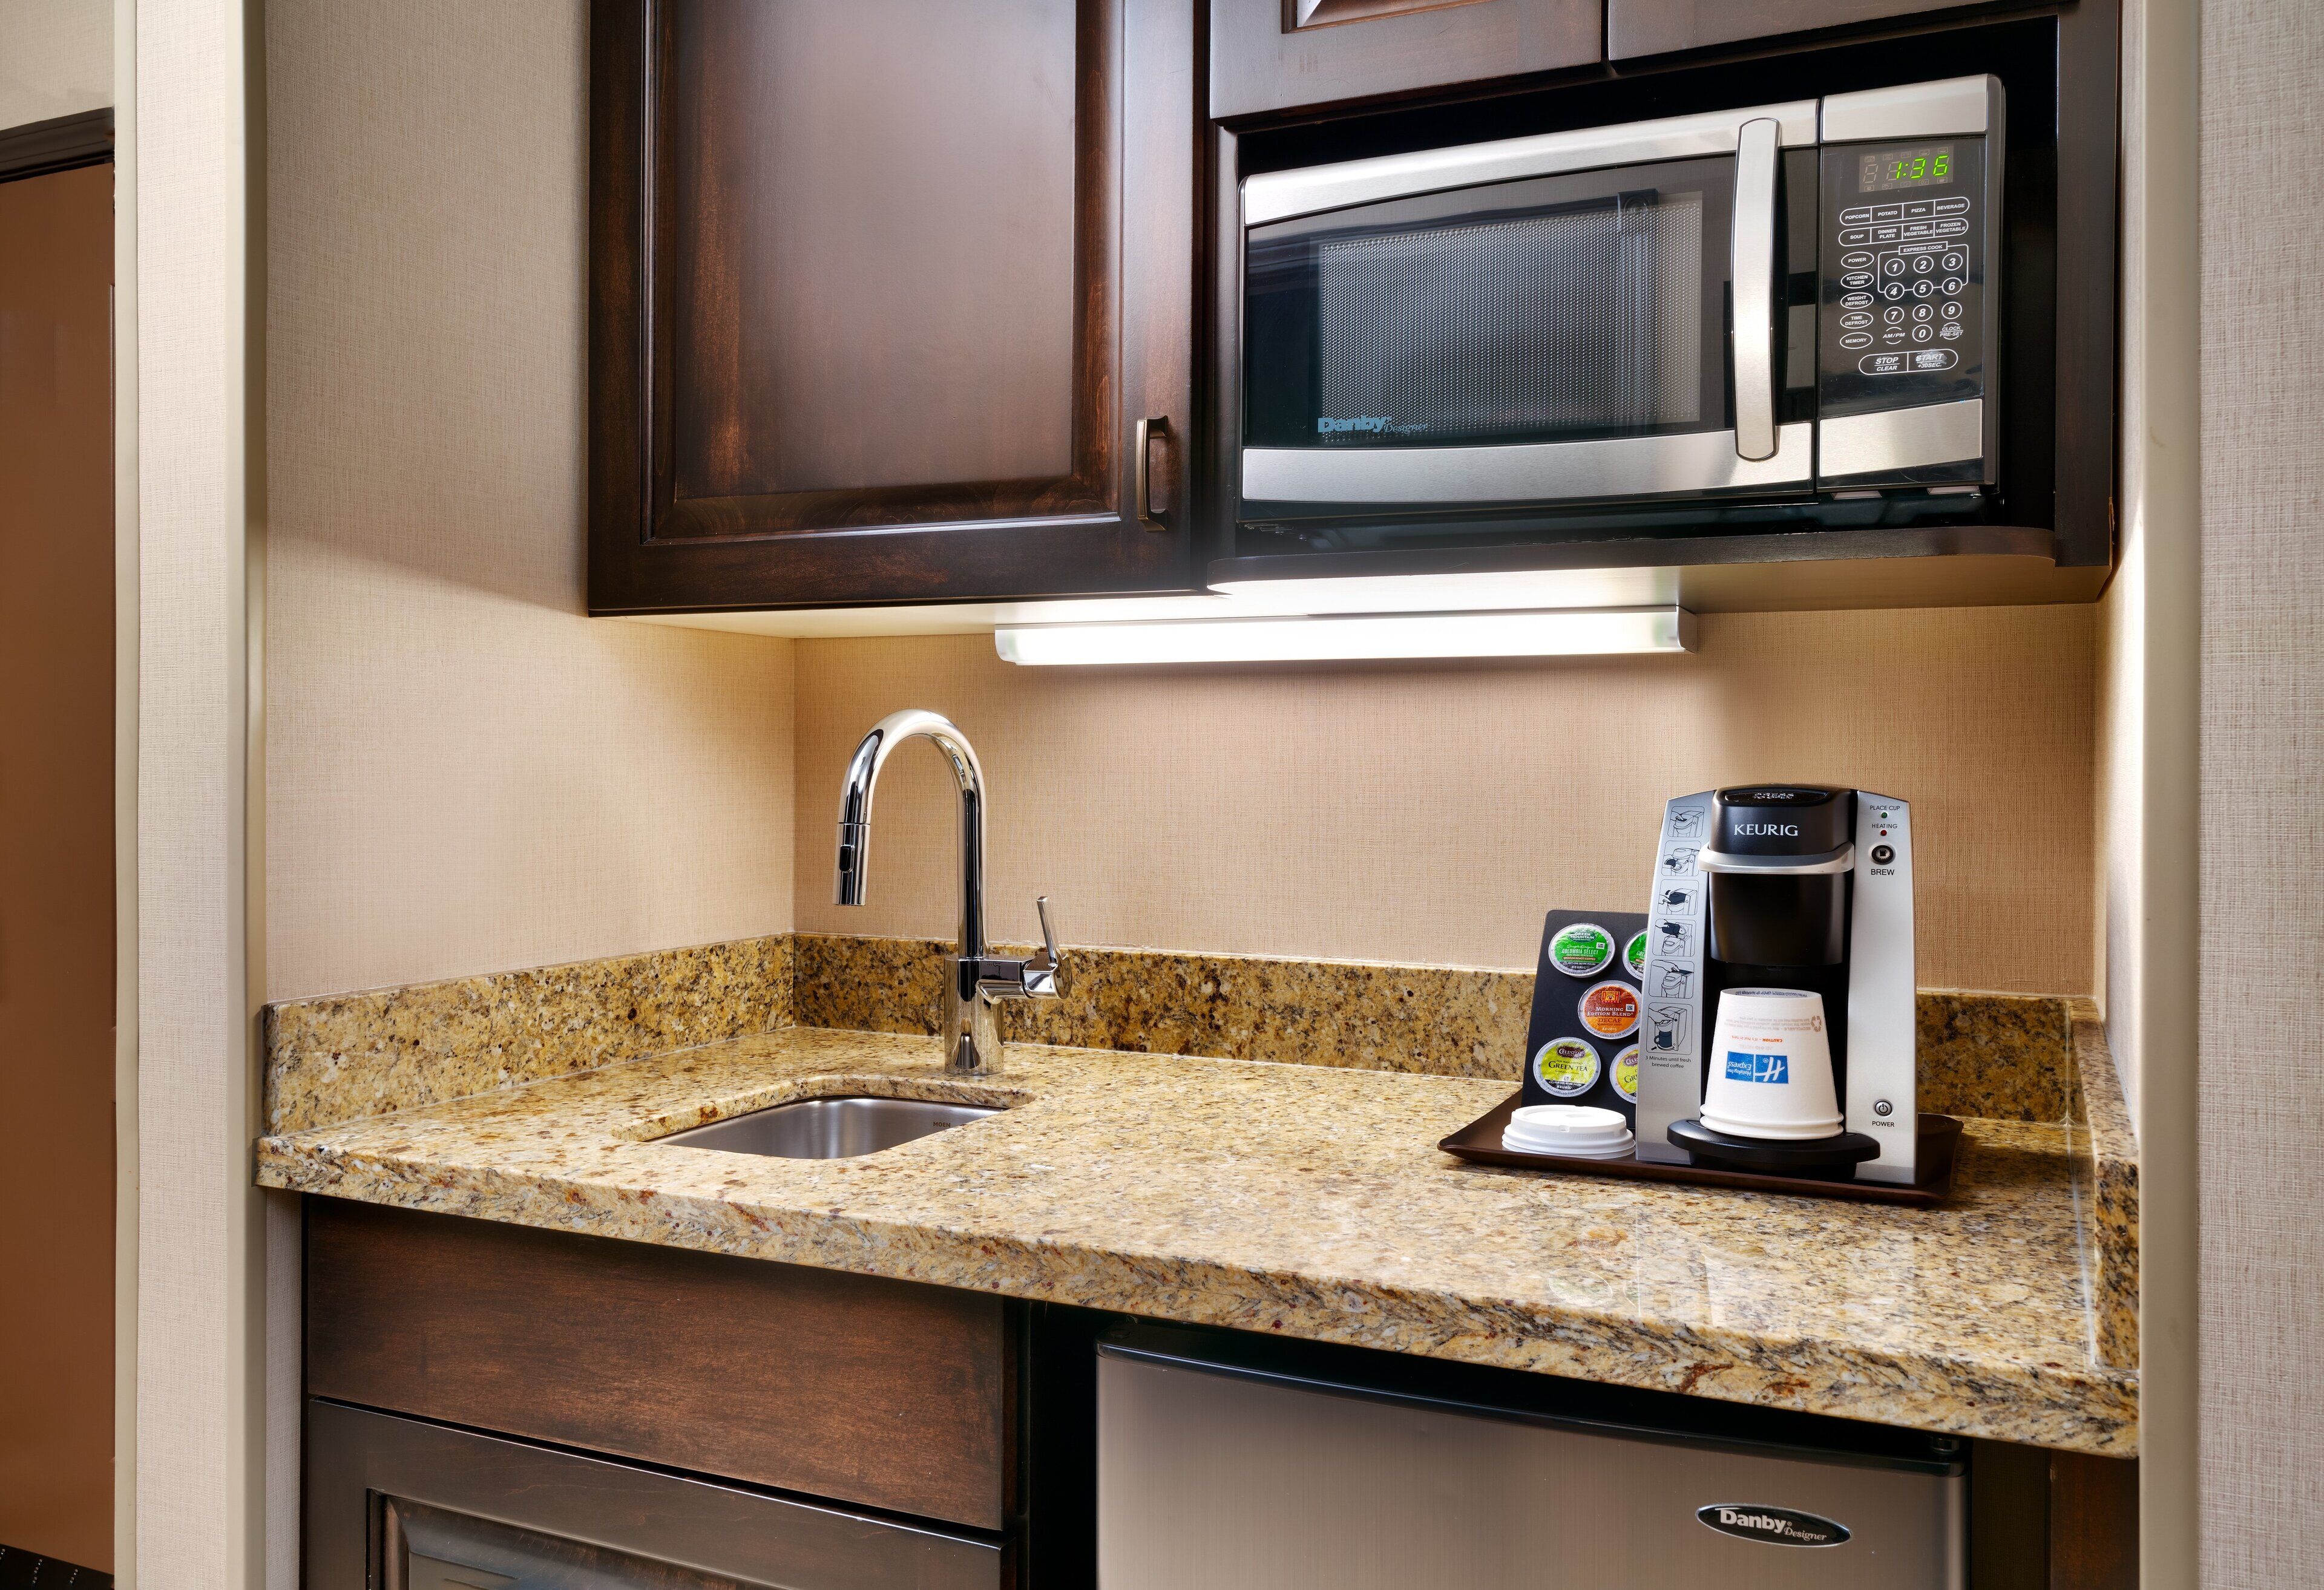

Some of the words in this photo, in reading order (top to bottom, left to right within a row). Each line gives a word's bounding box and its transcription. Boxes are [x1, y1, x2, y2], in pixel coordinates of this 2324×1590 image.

[1896, 154, 1949, 180] 1:36
[1919, 260, 1927, 269] 2
[1948, 257, 1956, 267] 3
[1892, 263, 1899, 272] 1
[1919, 284, 1926, 293] 5
[1948, 281, 1955, 291] 6
[1889, 286, 1898, 296] 4
[1919, 308, 1926, 317] 8
[1948, 306, 1955, 315] 9
[1891, 311, 1899, 320] 7
[1919, 329, 1926, 338] 0
[1915, 353, 1944, 362] START
[1318, 416, 1387, 433] Danby
[1383, 424, 1427, 434] Designer
[1733, 823, 1799, 836] KEURIG
[1558, 1048, 1582, 1056] CELESTIAL
[1548, 1061, 1574, 1070] GREEN
[1728, 1061, 1752, 1070] Express
[1719, 1509, 1787, 1534] Danby
[1784, 1527, 1827, 1541] Designer
